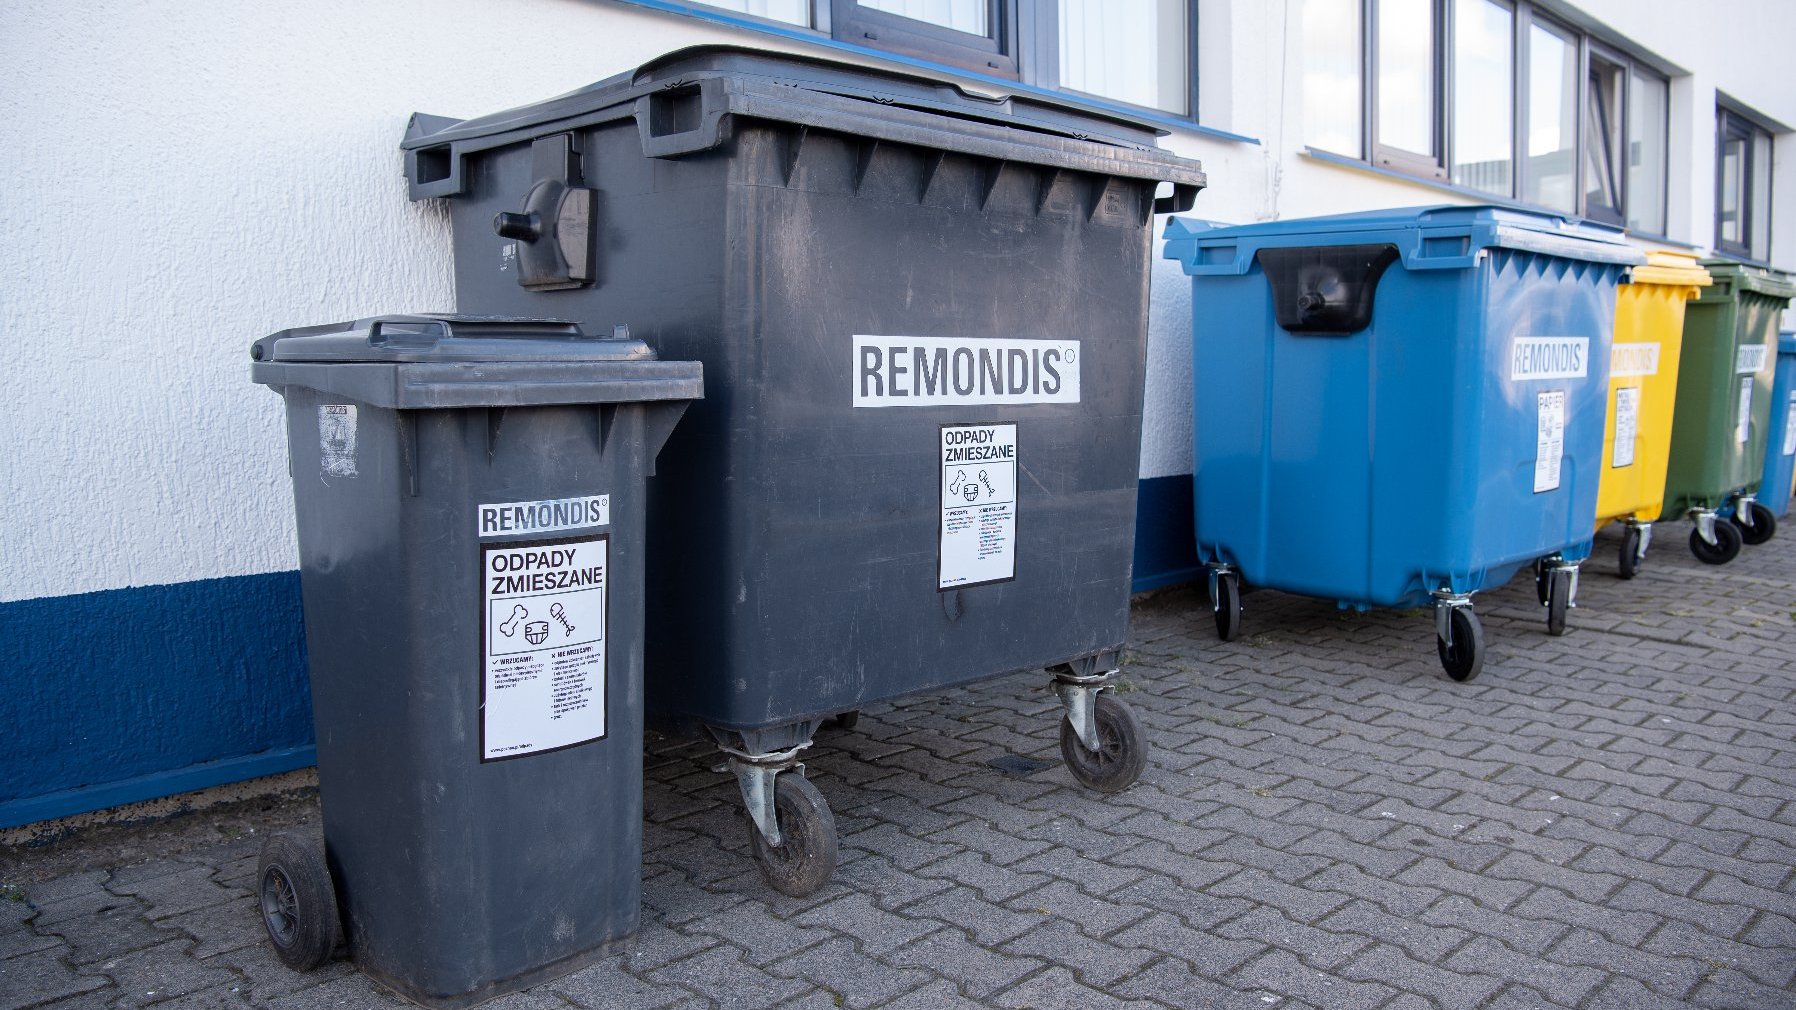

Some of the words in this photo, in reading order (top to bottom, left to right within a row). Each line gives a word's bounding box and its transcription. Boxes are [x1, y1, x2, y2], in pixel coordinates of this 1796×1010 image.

[860, 345, 1061, 397] REMONDIS
[1513, 343, 1581, 374] REMONDIS
[945, 430, 995, 445] ODPADY
[945, 445, 1014, 462] ZMIESZANE
[482, 500, 600, 532] REMONDIS
[491, 549, 577, 573] ODPADY
[491, 566, 603, 595] ZMIESZANE
